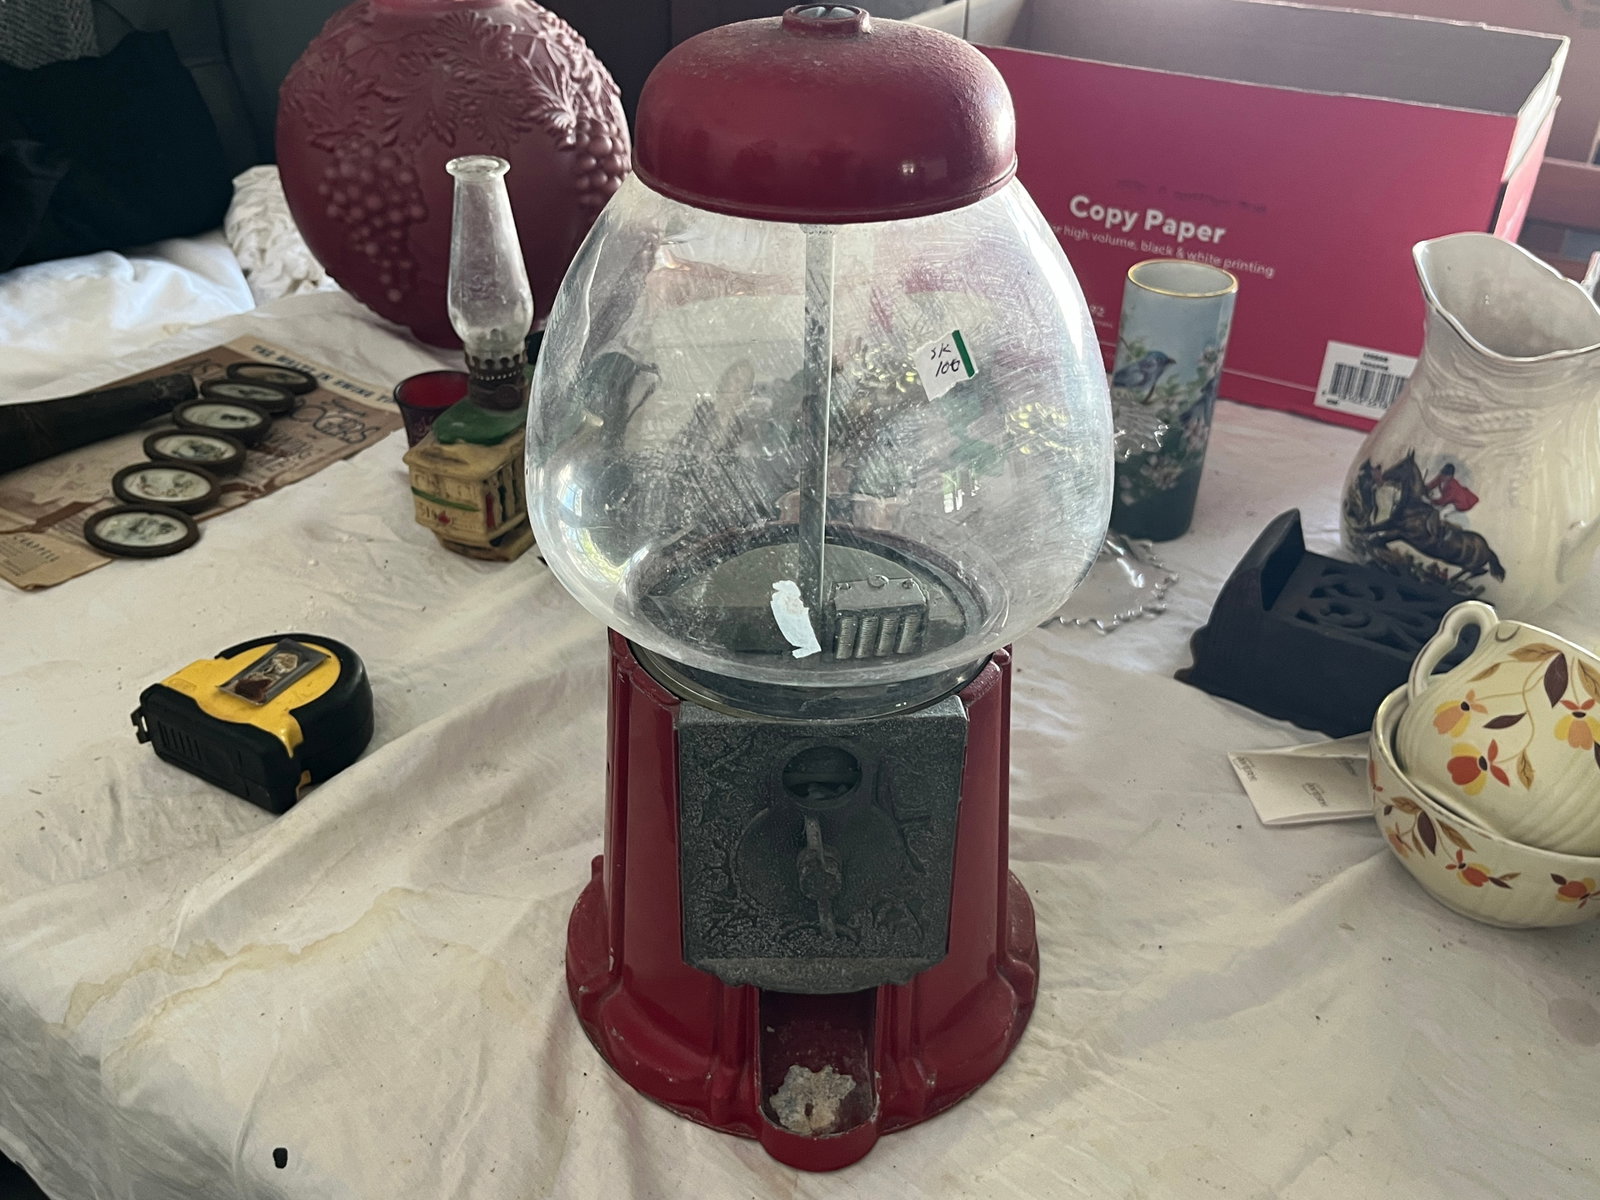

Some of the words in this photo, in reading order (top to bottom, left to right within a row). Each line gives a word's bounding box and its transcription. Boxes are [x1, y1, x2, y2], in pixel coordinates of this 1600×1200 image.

[1069, 195, 1139, 232] Copy
[1144, 208, 1226, 243] Paper
[1063, 225, 1089, 241] high
[1091, 233, 1139, 251] volume,
[1140, 240, 1173, 256] black
[1175, 247, 1185, 259] &
[1187, 250, 1221, 265] white
[1223, 259, 1275, 280] printing
